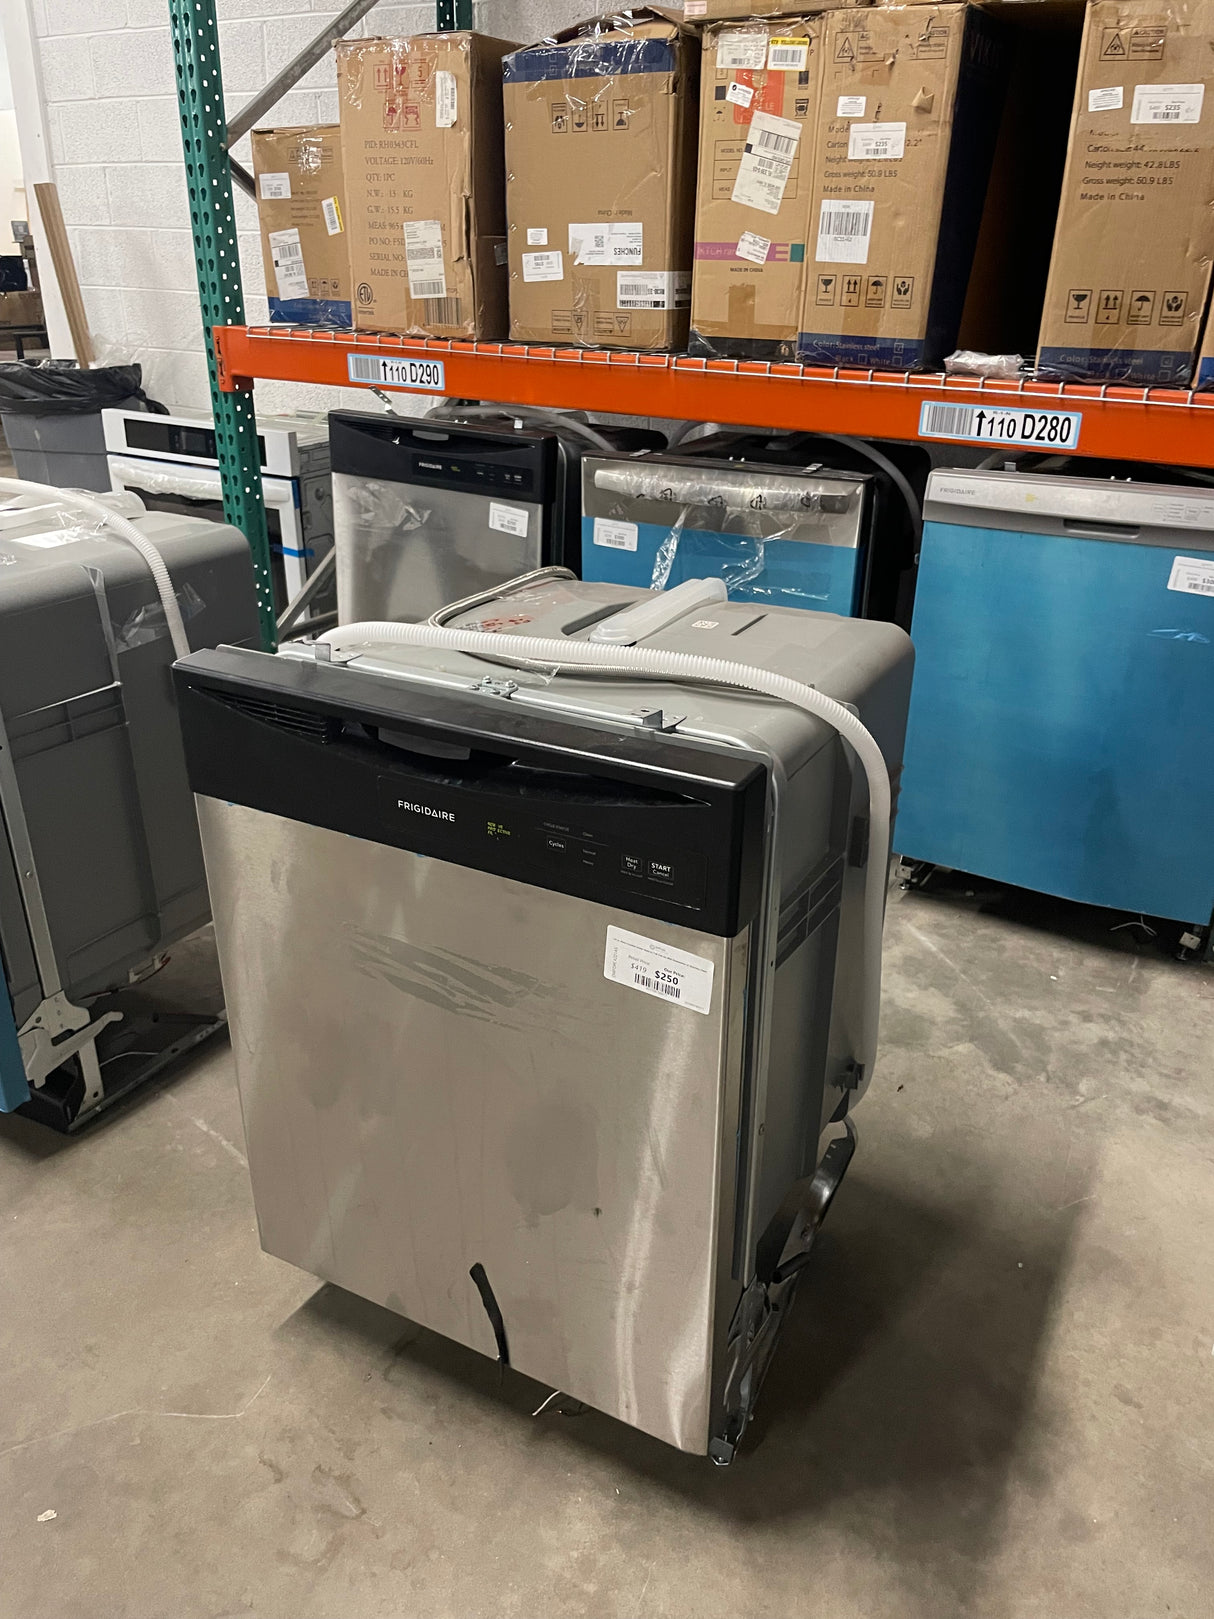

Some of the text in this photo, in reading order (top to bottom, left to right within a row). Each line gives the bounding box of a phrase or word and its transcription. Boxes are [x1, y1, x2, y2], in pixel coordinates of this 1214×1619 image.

[828, 125, 849, 133] Mode
[822, 185, 875, 193] Made in China
[402, 189, 414, 199] KG
[1080, 193, 1145, 201] Made in China
[402, 206, 414, 215] KG
[613, 247, 642, 256] FUNCHES
[370, 268, 390, 277] MADE
[390, 268, 399, 277] IN
[389, 362, 440, 386] 110 D290
[987, 413, 1072, 443] 110 D280
[397, 799, 456, 823] FRIGIDAIRE
[548, 839, 565, 849] Cycles
[626, 862, 637, 871] Dry
[651, 862, 671, 873] START
[652, 869, 670, 878] Cancel
[630, 962, 648, 974] $419
[654, 970, 679, 986] $250
